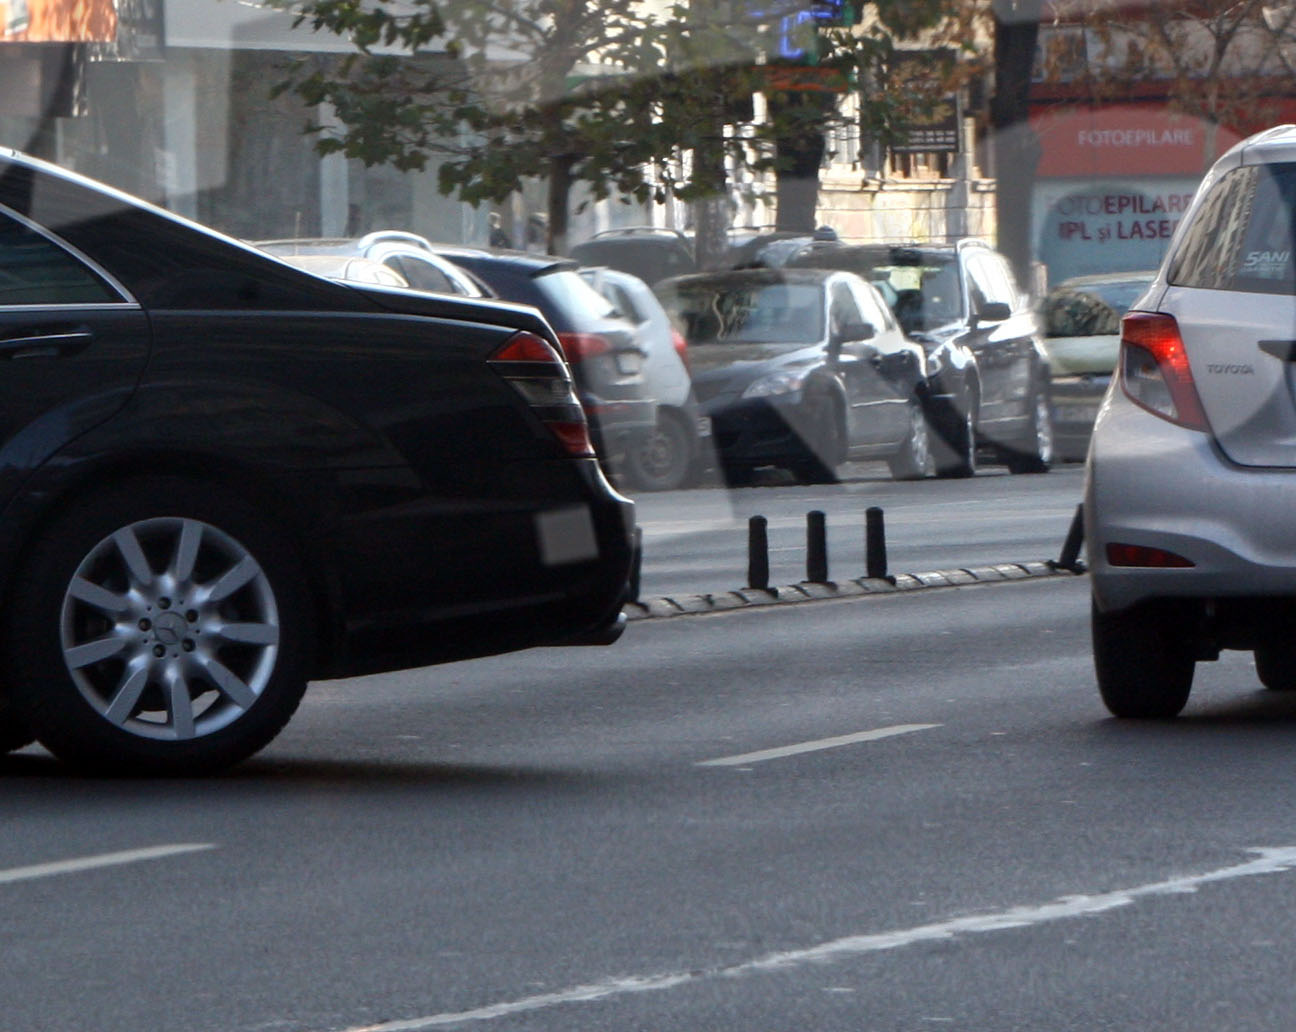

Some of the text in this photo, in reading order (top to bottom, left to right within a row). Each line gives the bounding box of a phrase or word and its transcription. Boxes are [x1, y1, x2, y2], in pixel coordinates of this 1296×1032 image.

[1077, 128, 1194, 146] FOTOEPILARE
[1059, 221, 1092, 241] IPL
[1207, 363, 1256, 376] TOYOTA
